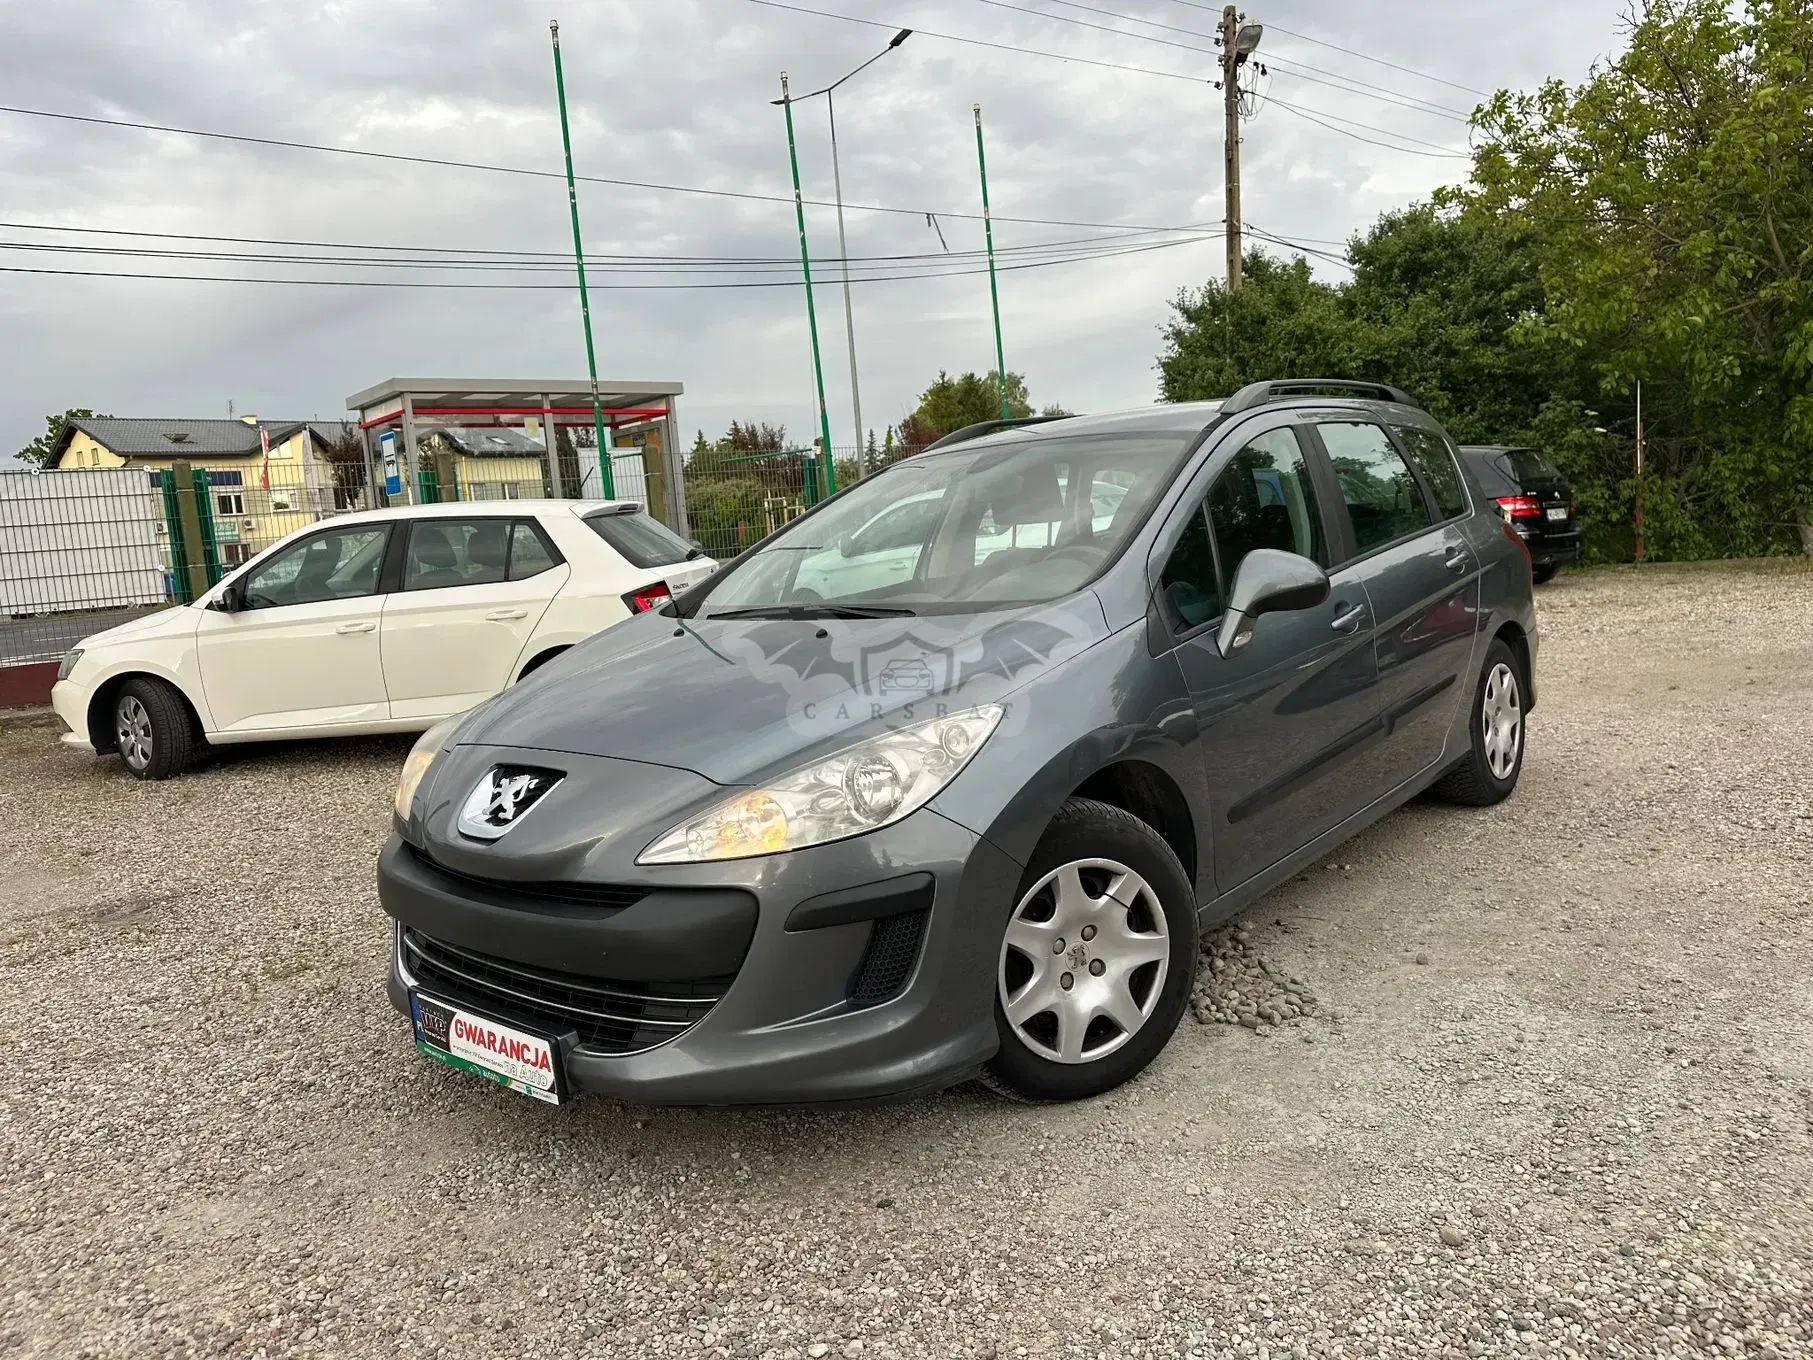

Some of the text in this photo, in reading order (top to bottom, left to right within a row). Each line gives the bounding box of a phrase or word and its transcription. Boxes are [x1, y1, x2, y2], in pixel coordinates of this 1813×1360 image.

[455, 1019, 551, 1073] GWARANCJA
[503, 1060, 548, 1087] na Auto
